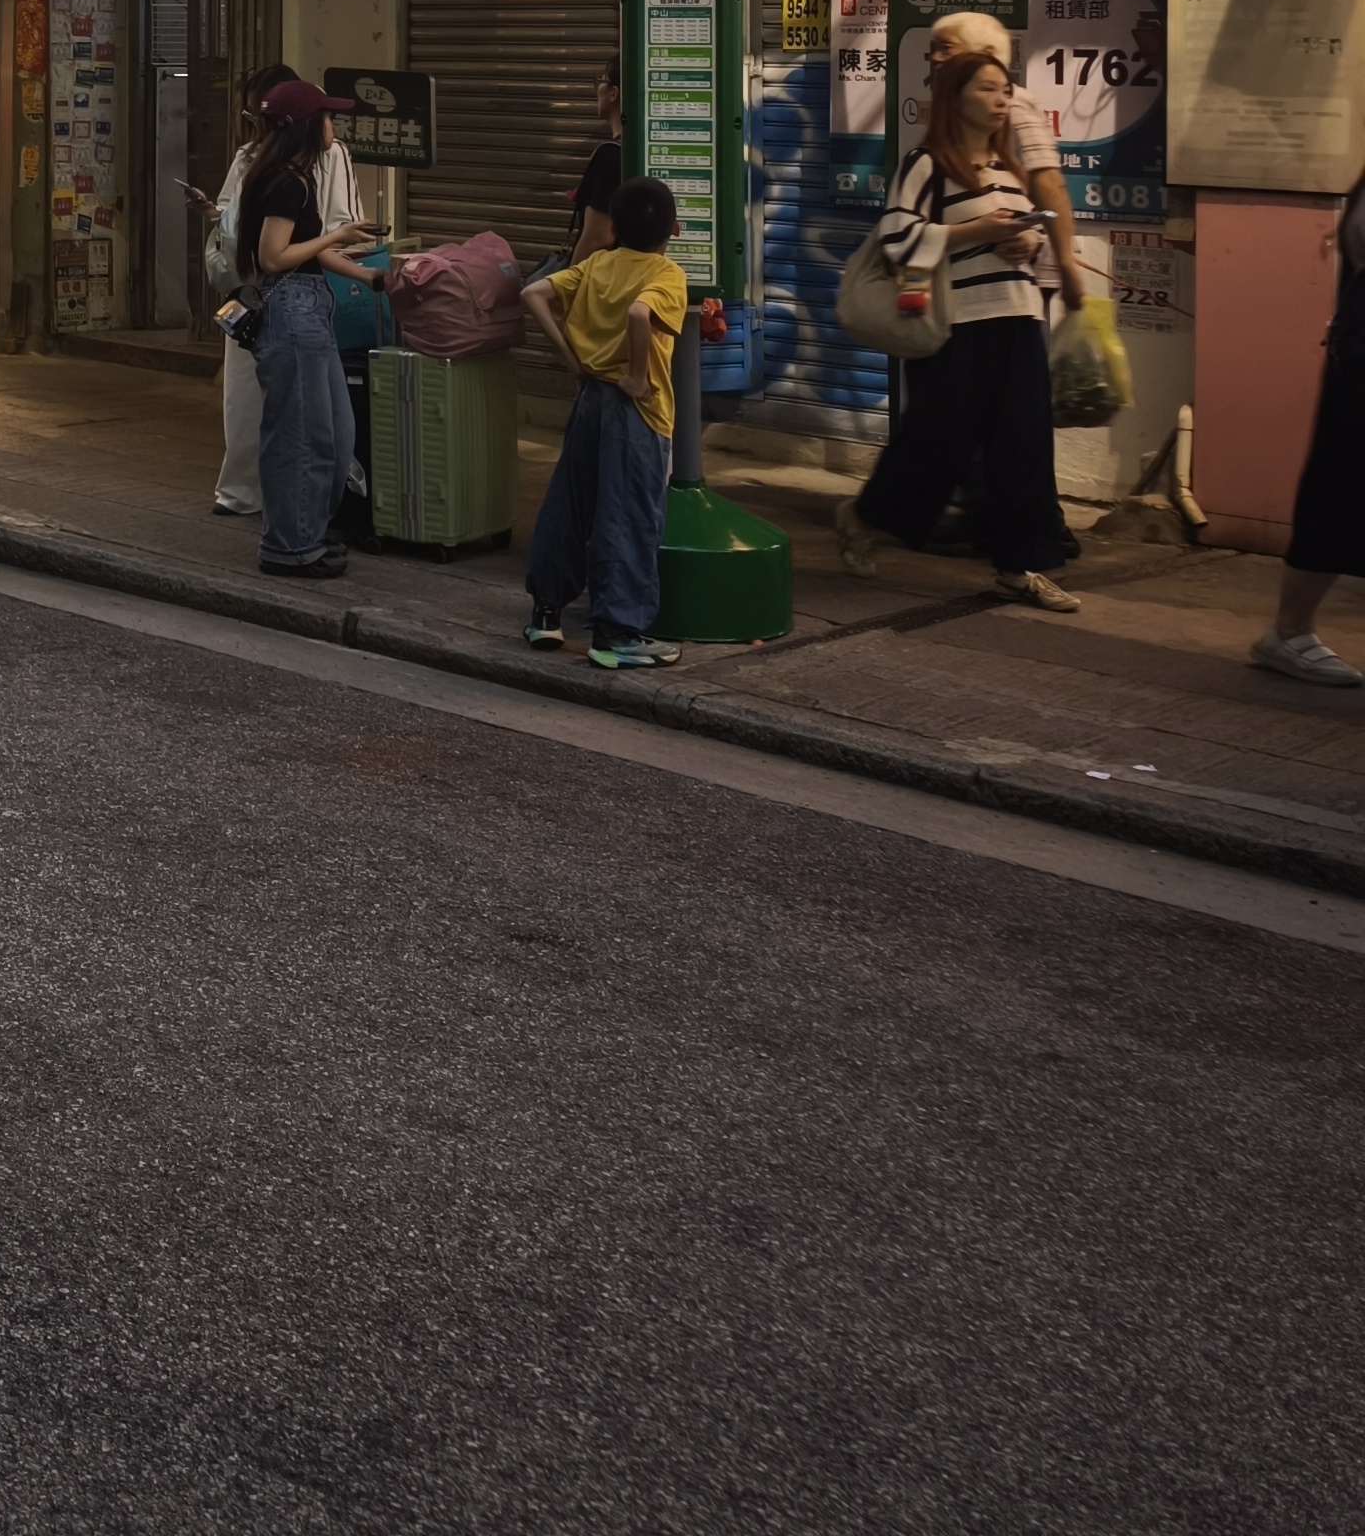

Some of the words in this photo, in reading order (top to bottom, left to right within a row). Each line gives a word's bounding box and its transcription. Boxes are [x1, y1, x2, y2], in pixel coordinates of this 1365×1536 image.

[1045, 0, 1109, 20] 租賃部
[787, 26, 818, 47] 5530
[333, 113, 422, 146] 永東巴士
[377, 146, 403, 156] EAST
[405, 148, 425, 158] BUS
